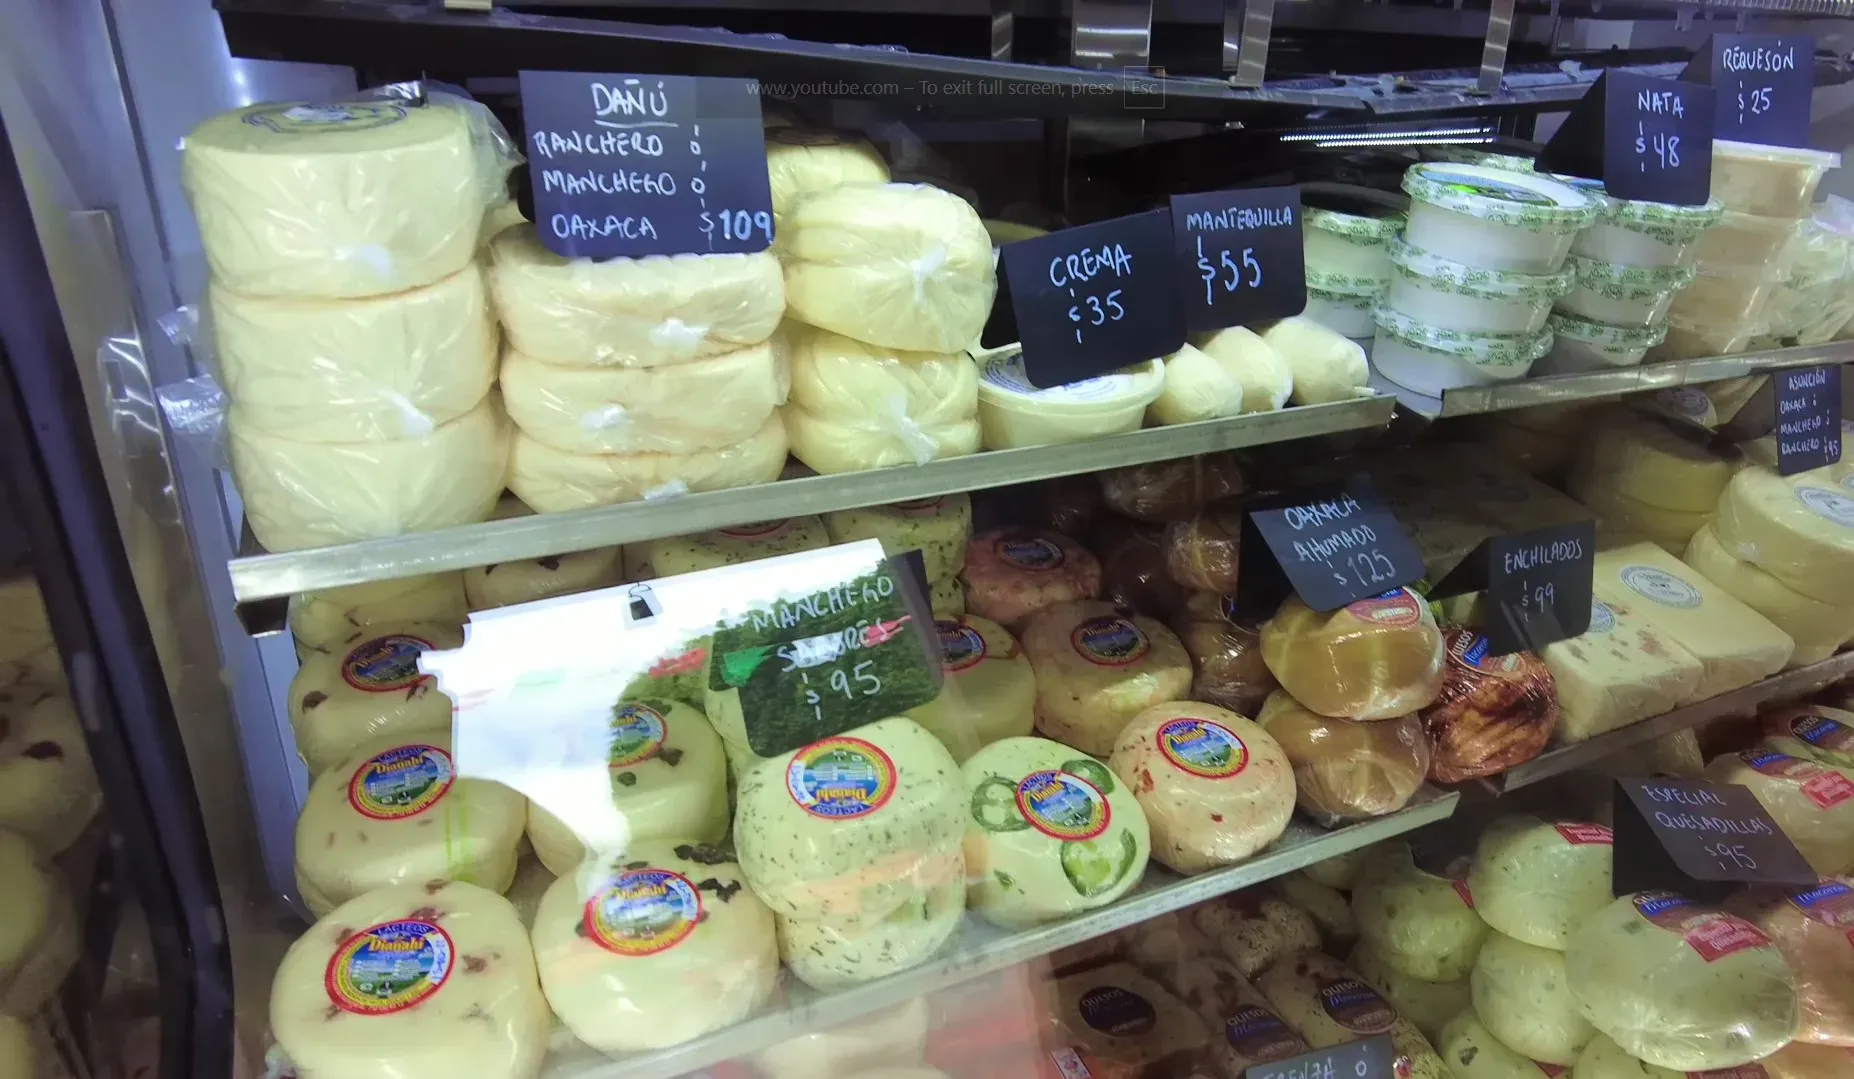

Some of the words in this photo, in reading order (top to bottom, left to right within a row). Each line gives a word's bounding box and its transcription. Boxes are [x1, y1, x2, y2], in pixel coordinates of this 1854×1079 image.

[1638, 88, 1684, 119] NATA
[1738, 80, 1773, 124] $25
[533, 129, 664, 159] RANCHERO
[1635, 120, 1681, 173] $48
[543, 169, 677, 196] MANCHEGO
[551, 213, 657, 240] OAXACA
[1186, 206, 1293, 232] MANTEQUILLA
[1049, 244, 1132, 287] CREMA
[1197, 235, 1263, 306] $55
[1788, 369, 1826, 390] ASUNCIÓN
[1780, 397, 1807, 415] OAXACA
[1780, 415, 1821, 435] MANCHEGO
[1781, 438, 1820, 456] RANCHERO
[1284, 493, 1361, 531] OAXACA
[1296, 524, 1377, 563] AHUMADO
[1504, 538, 1583, 574] ENCHILADOS
[752, 576, 894, 632] MANCHEGO
[1522, 581, 1555, 622] $99
[802, 660, 882, 721] $95
[1641, 785, 1728, 806] ESPECIAL
[1655, 811, 1774, 835] QUESADILLAS
[1699, 836, 1758, 871] $95
